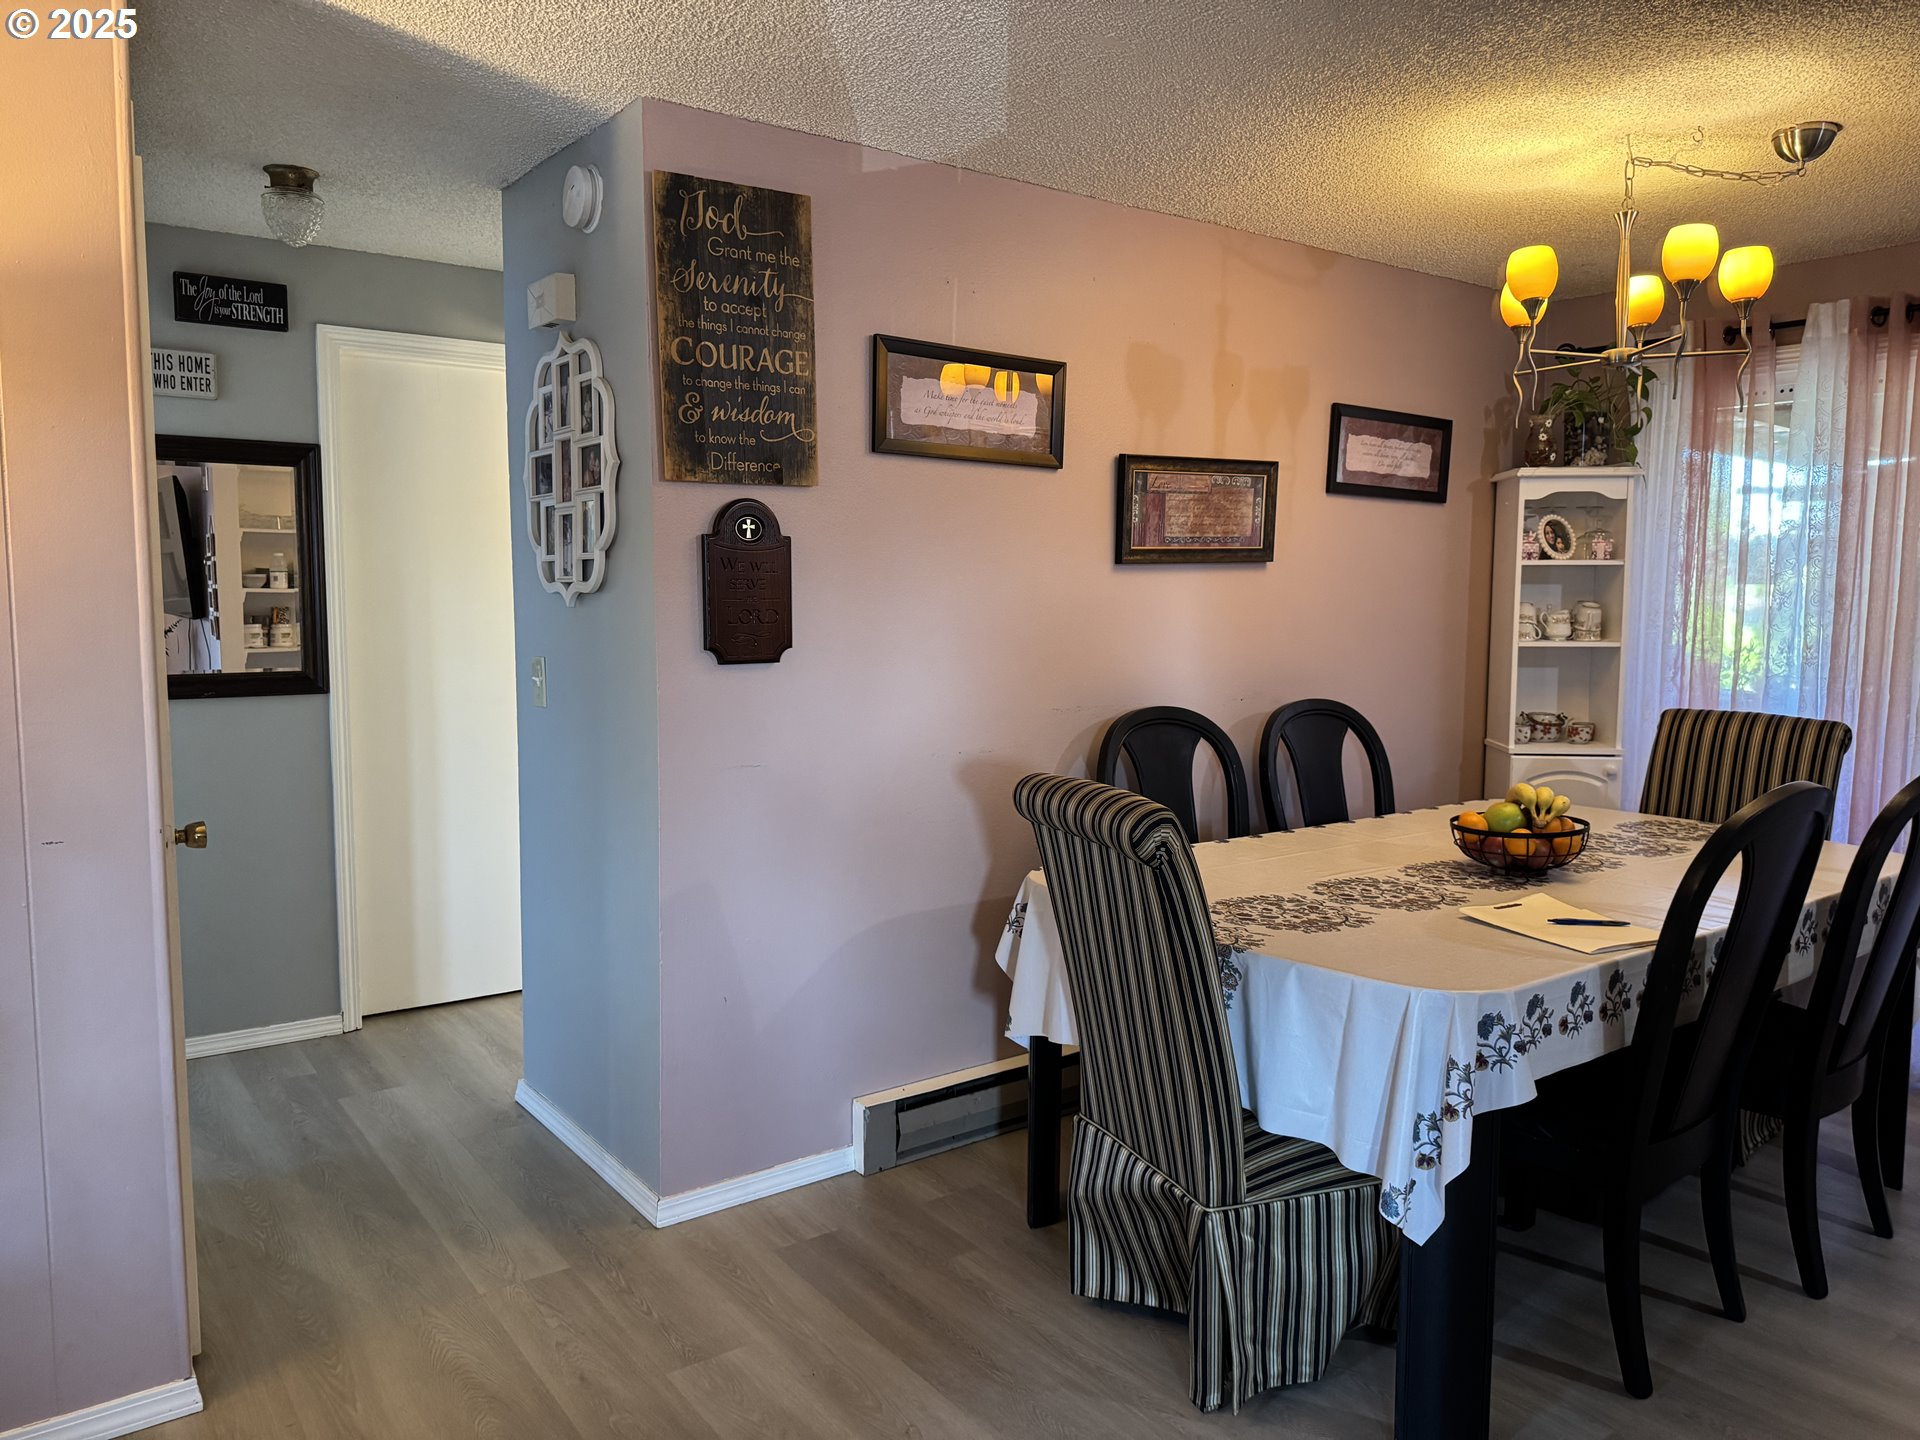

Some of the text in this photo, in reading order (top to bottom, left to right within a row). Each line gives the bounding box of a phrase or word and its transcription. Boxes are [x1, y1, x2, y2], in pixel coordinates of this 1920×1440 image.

[679, 189, 784, 240] God
[707, 237, 800, 267] Grant me the
[180, 276, 263, 321] The Joy of the Lord
[671, 259, 814, 313] Serenity
[219, 306, 231, 318] your
[232, 303, 284, 324] STRENGTH
[703, 297, 767, 318] to accept
[678, 316, 695, 329] the
[698, 315, 727, 334] things
[736, 322, 769, 336] cannot
[772, 324, 806, 342] change
[670, 336, 810, 376] COURAGE
[154, 373, 211, 392] WHO ENTER
[682, 374, 693, 386] to
[695, 376, 732, 392] change
[734, 377, 750, 391] the
[752, 379, 781, 395] things
[789, 384, 806, 395] can
[678, 391, 815, 442] & wisdom
[694, 428, 756, 445] to know the
[711, 451, 781, 472] Difference
